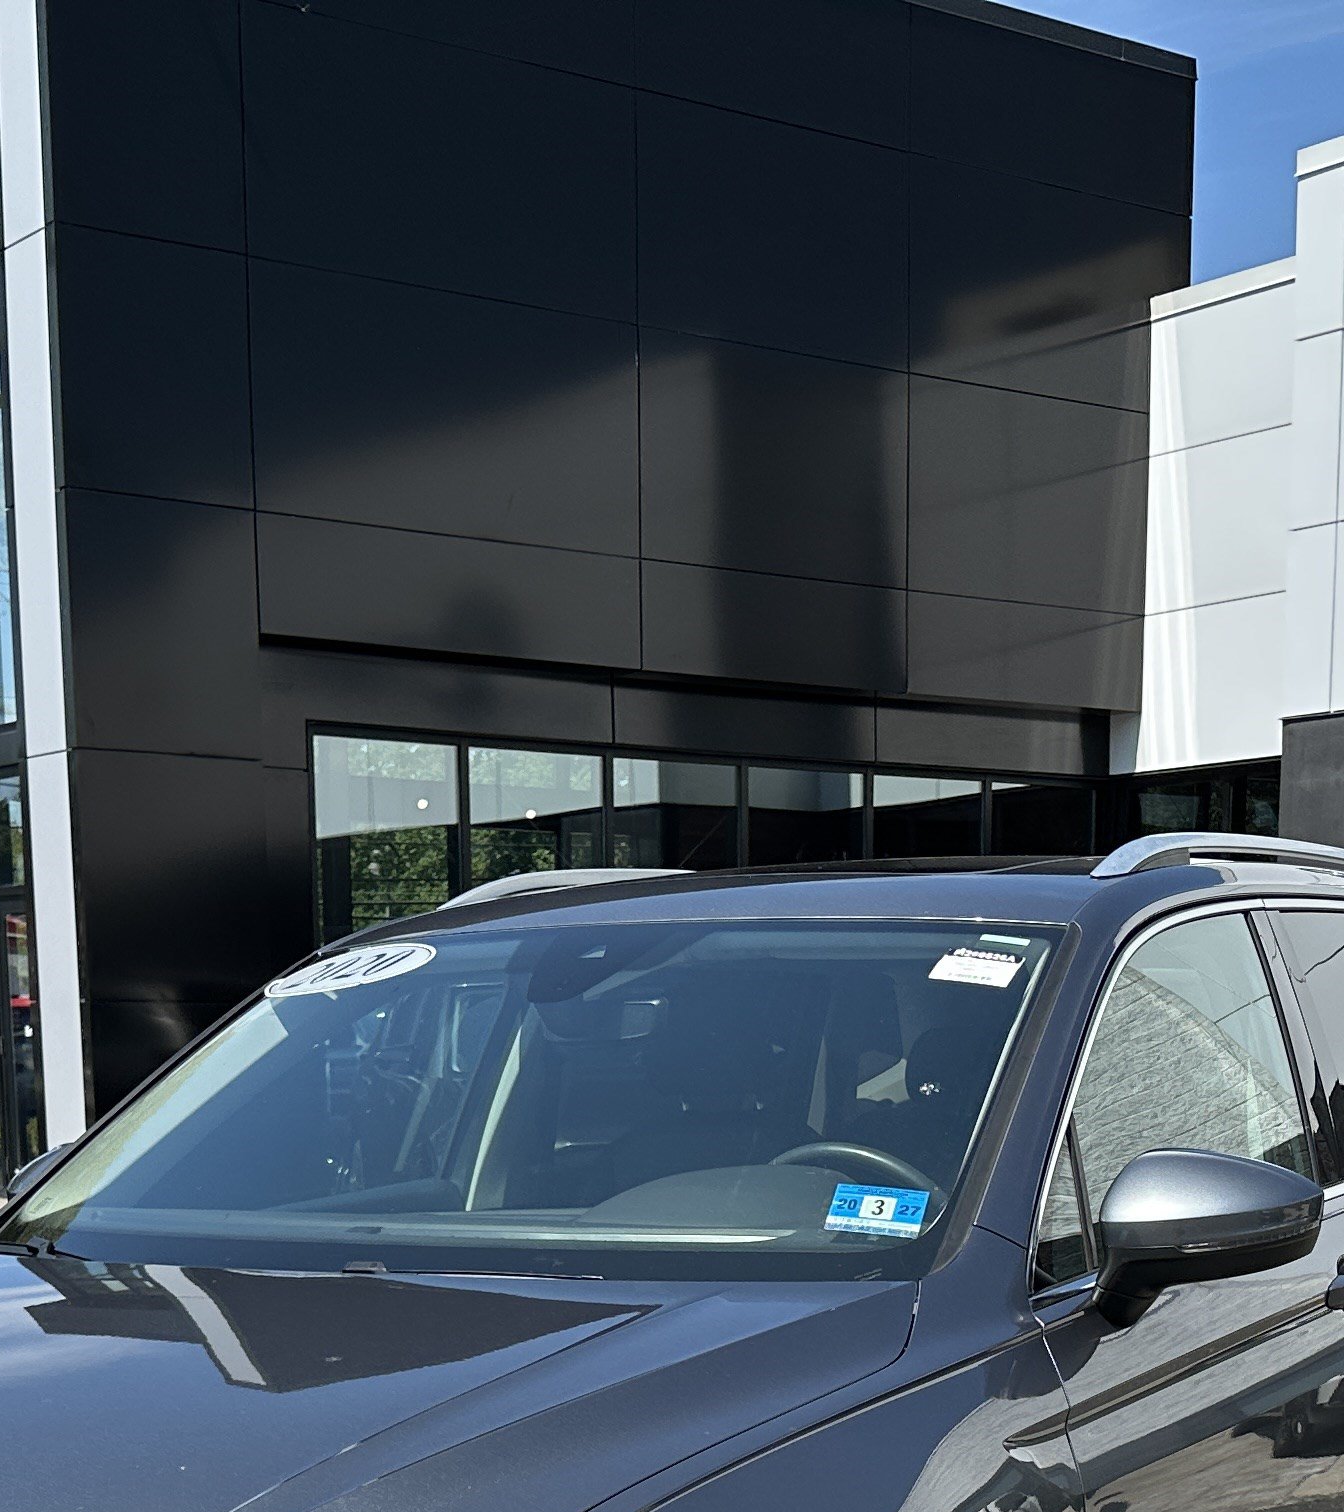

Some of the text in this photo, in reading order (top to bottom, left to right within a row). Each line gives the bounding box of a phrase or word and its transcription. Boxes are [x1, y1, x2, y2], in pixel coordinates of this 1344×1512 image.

[281, 949, 416, 990] 2020
[837, 1198, 922, 1217] 20 3 27
